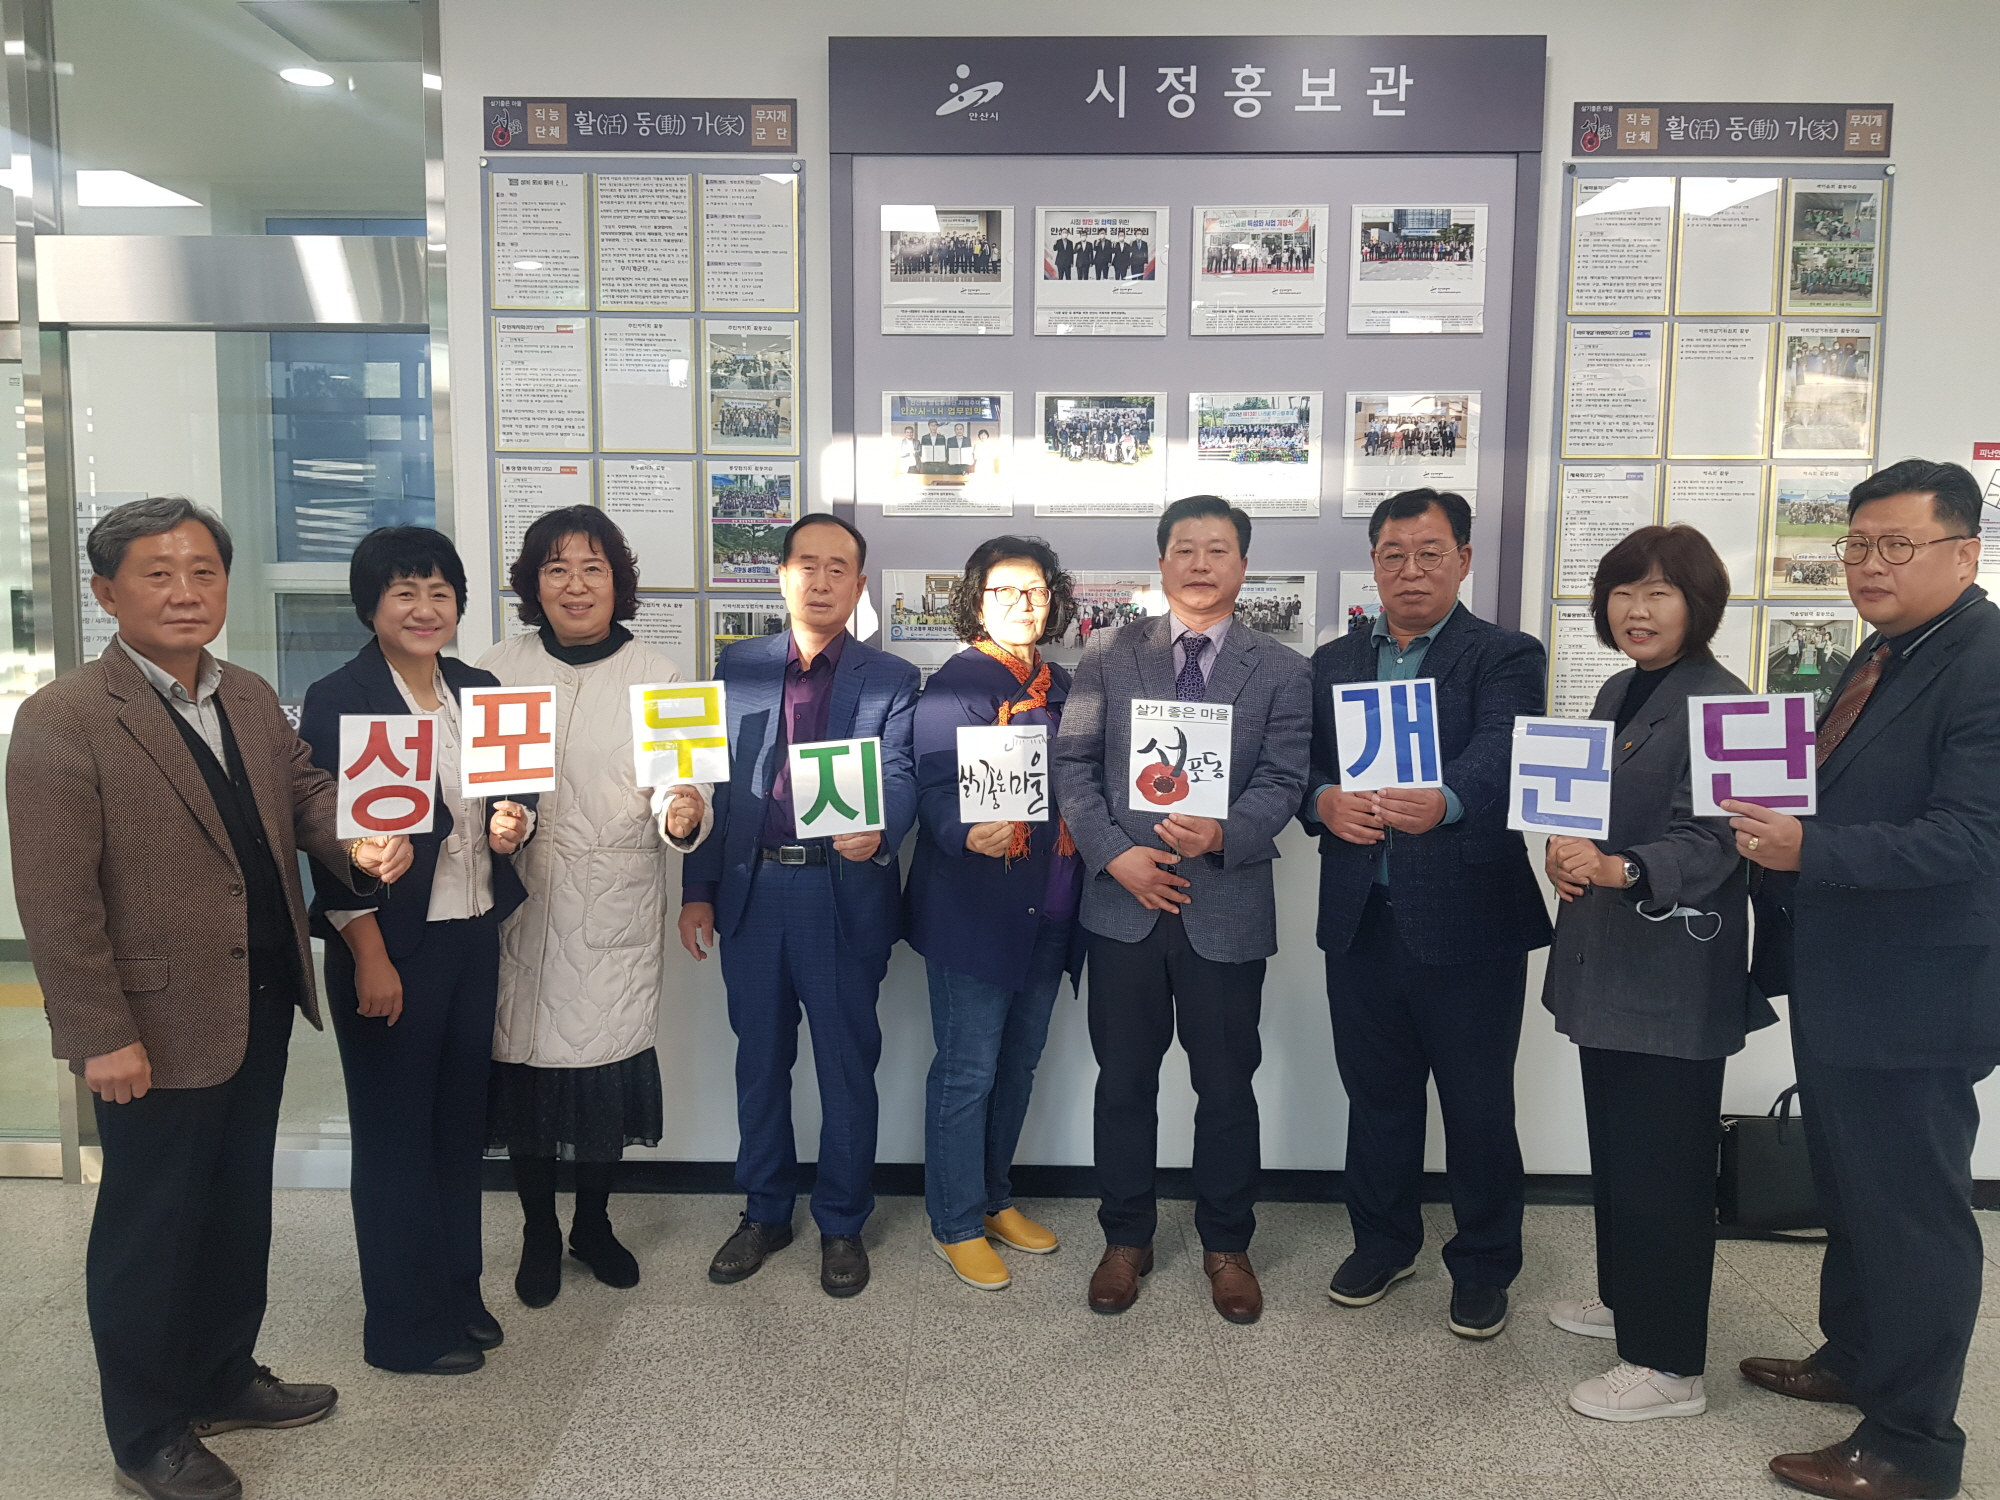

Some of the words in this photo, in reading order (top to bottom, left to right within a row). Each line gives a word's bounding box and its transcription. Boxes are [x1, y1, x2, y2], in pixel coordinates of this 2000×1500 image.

[574, 110, 627, 136] 활(活)
[633, 112, 686, 136] 동(動)
[692, 112, 745, 136] 가(家)
[755, 110, 787, 122] 무지개
[968, 112, 999, 121] 안산시
[1665, 115, 1720, 141] 활(活)
[1725, 117, 1779, 141] 동(動)
[1785, 117, 1838, 141] 가(家)
[1850, 115, 1882, 127] 무지개
[468, 691, 554, 784] 포
[641, 686, 726, 778] 무
[1136, 705, 1163, 717] 살기
[1168, 706, 1196, 718] 좋은
[1201, 708, 1229, 720] 마을
[1342, 682, 1438, 783] 개
[1702, 697, 1815, 808] 단
[344, 720, 433, 832] 성
[799, 741, 880, 826] 지
[1519, 723, 1610, 831] 군
